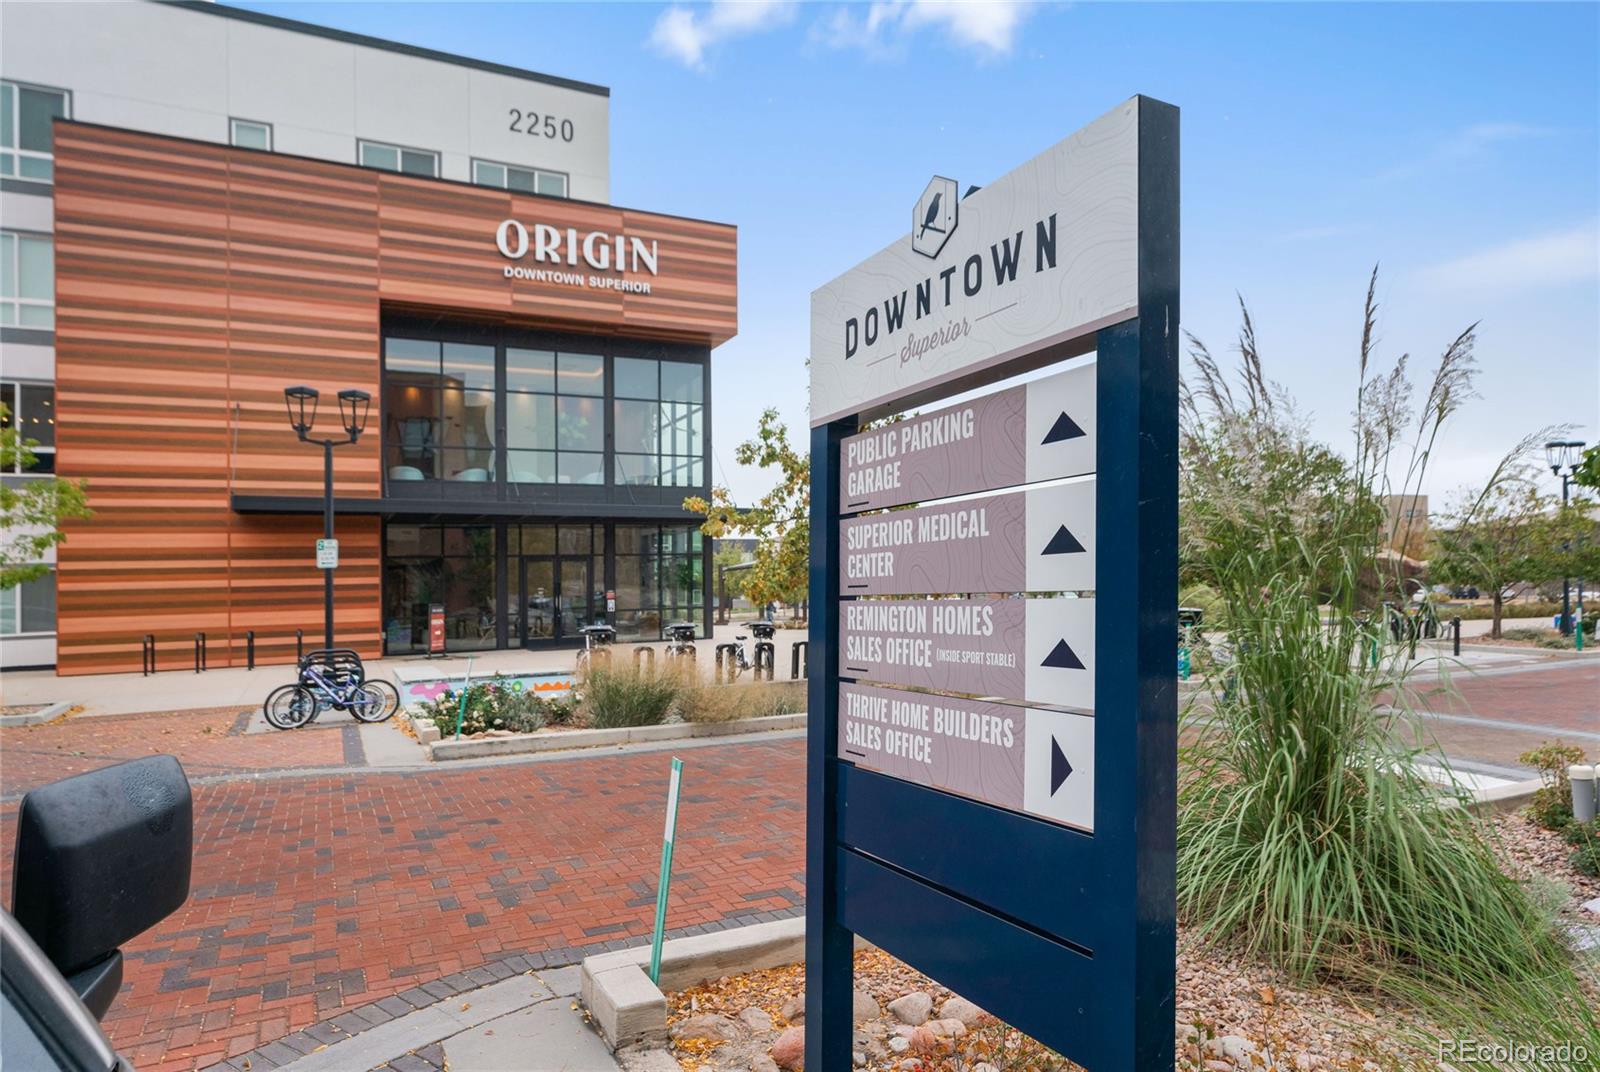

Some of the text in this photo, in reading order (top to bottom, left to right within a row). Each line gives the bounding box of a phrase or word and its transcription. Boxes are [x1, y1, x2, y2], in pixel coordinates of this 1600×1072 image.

[509, 108, 574, 142] 2250
[496, 219, 658, 276] ORIGIN
[504, 265, 651, 295] DOWNTOWN SUPERIOR
[845, 213, 1058, 360] DOWNTOWN
[900, 316, 972, 368] Superior
[848, 408, 974, 468] PUBLIC PARKING
[848, 461, 901, 497] GARAGE
[847, 508, 989, 550] SUPERIOR MEDICAL
[848, 552, 894, 578] CENTER
[847, 605, 993, 637] REMINGTON HOMES
[847, 636, 882, 663] SALES
[886, 639, 932, 668] OFFICE
[961, 651, 985, 665] SPORT
[846, 693, 1014, 748] THRIVE HOME BUILDERS
[846, 721, 932, 764] SALES OFFICE
